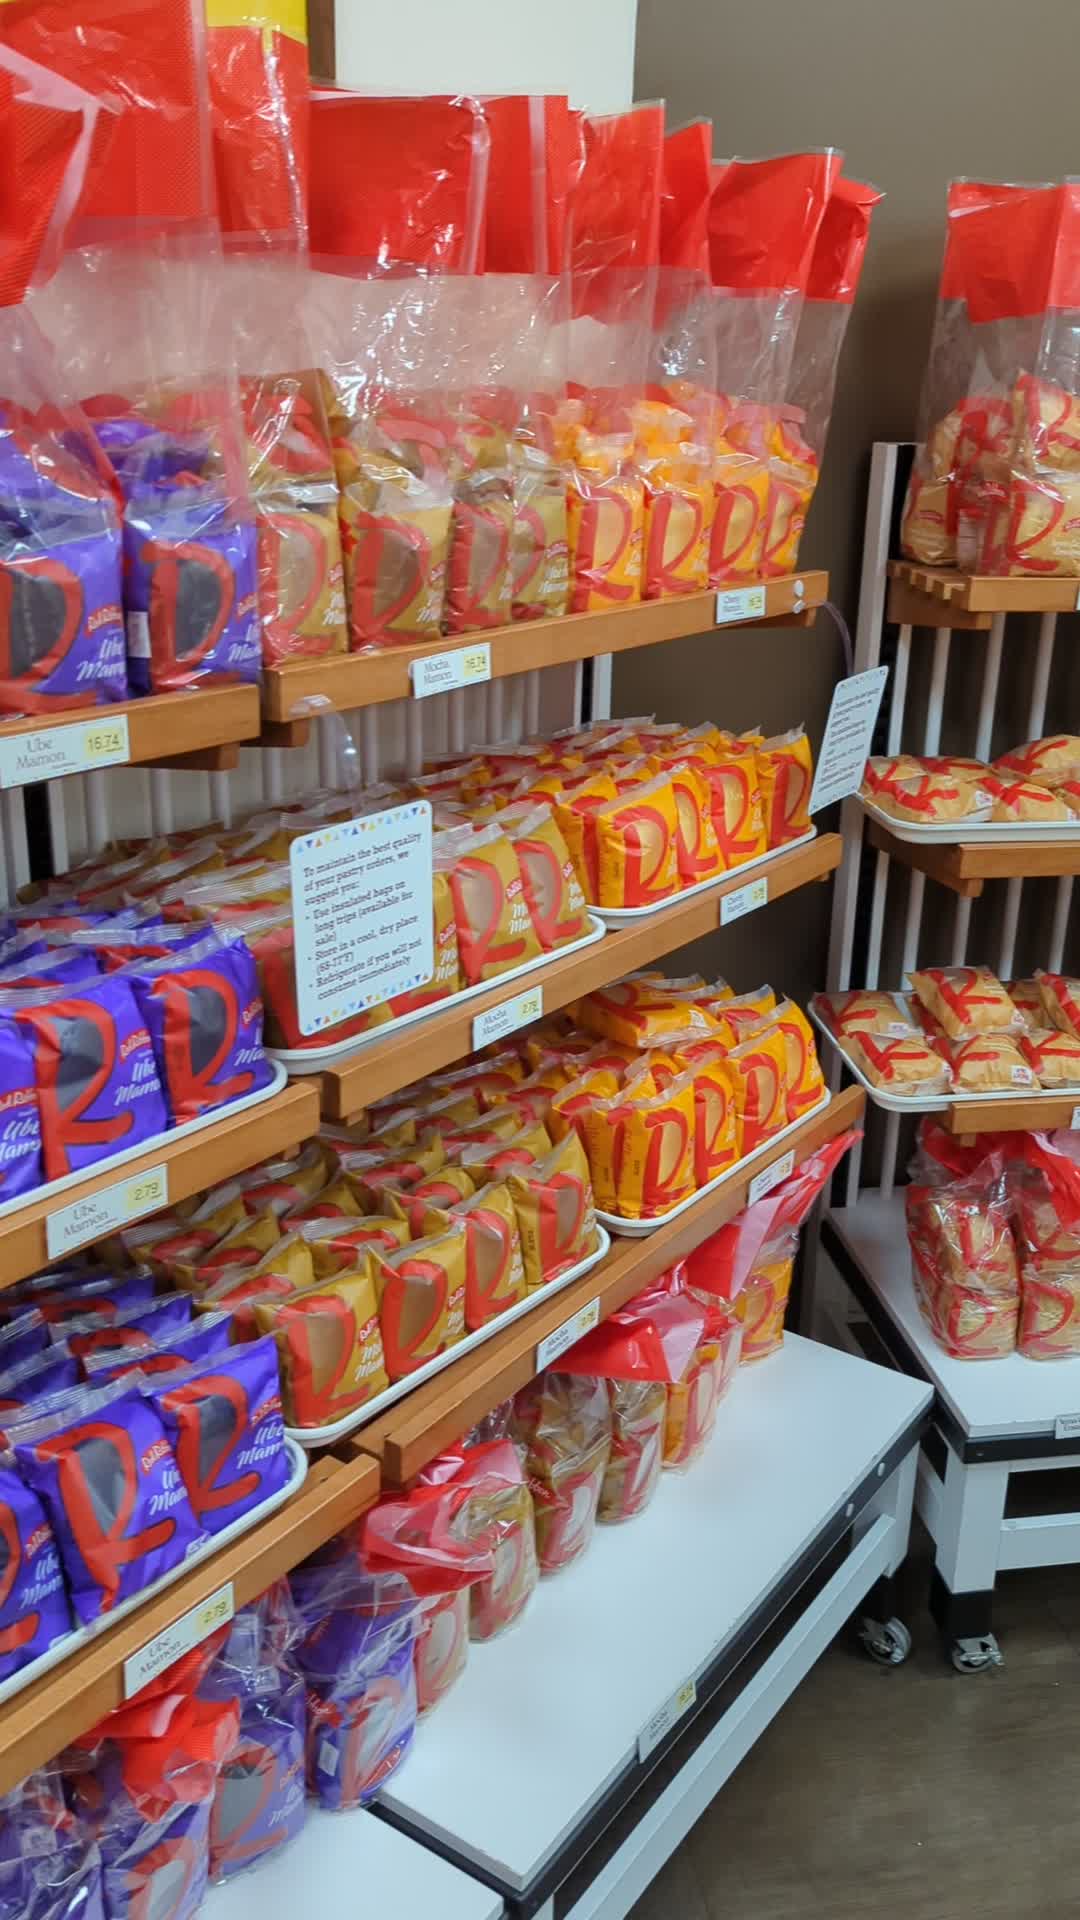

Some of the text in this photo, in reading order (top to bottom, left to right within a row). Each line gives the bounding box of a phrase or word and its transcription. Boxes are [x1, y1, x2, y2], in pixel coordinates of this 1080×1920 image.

[25, 736, 53, 753] Ube
[16, 751, 66, 769] Mamon
[303, 833, 422, 878] To maintain the best quality
[303, 880, 314, 892] of
[314, 875, 335, 891] your
[336, 865, 364, 883] pastry
[397, 851, 409, 860] we
[304, 887, 339, 906] suggest
[331, 890, 371, 913] insulated
[373, 884, 394, 898] bags
[314, 920, 334, 933] long
[336, 911, 357, 925] trips
[401, 891, 414, 901] for
[315, 946, 338, 960] Store
[339, 942, 350, 952] in
[379, 925, 394, 935] dry
[395, 915, 419, 932] place
[375, 952, 390, 966] you
[391, 943, 408, 956] will
[408, 937, 422, 950] not
[317, 978, 357, 1000] consume
[358, 955, 411, 983] immediately
[254, 1422, 285, 1445] Ube
